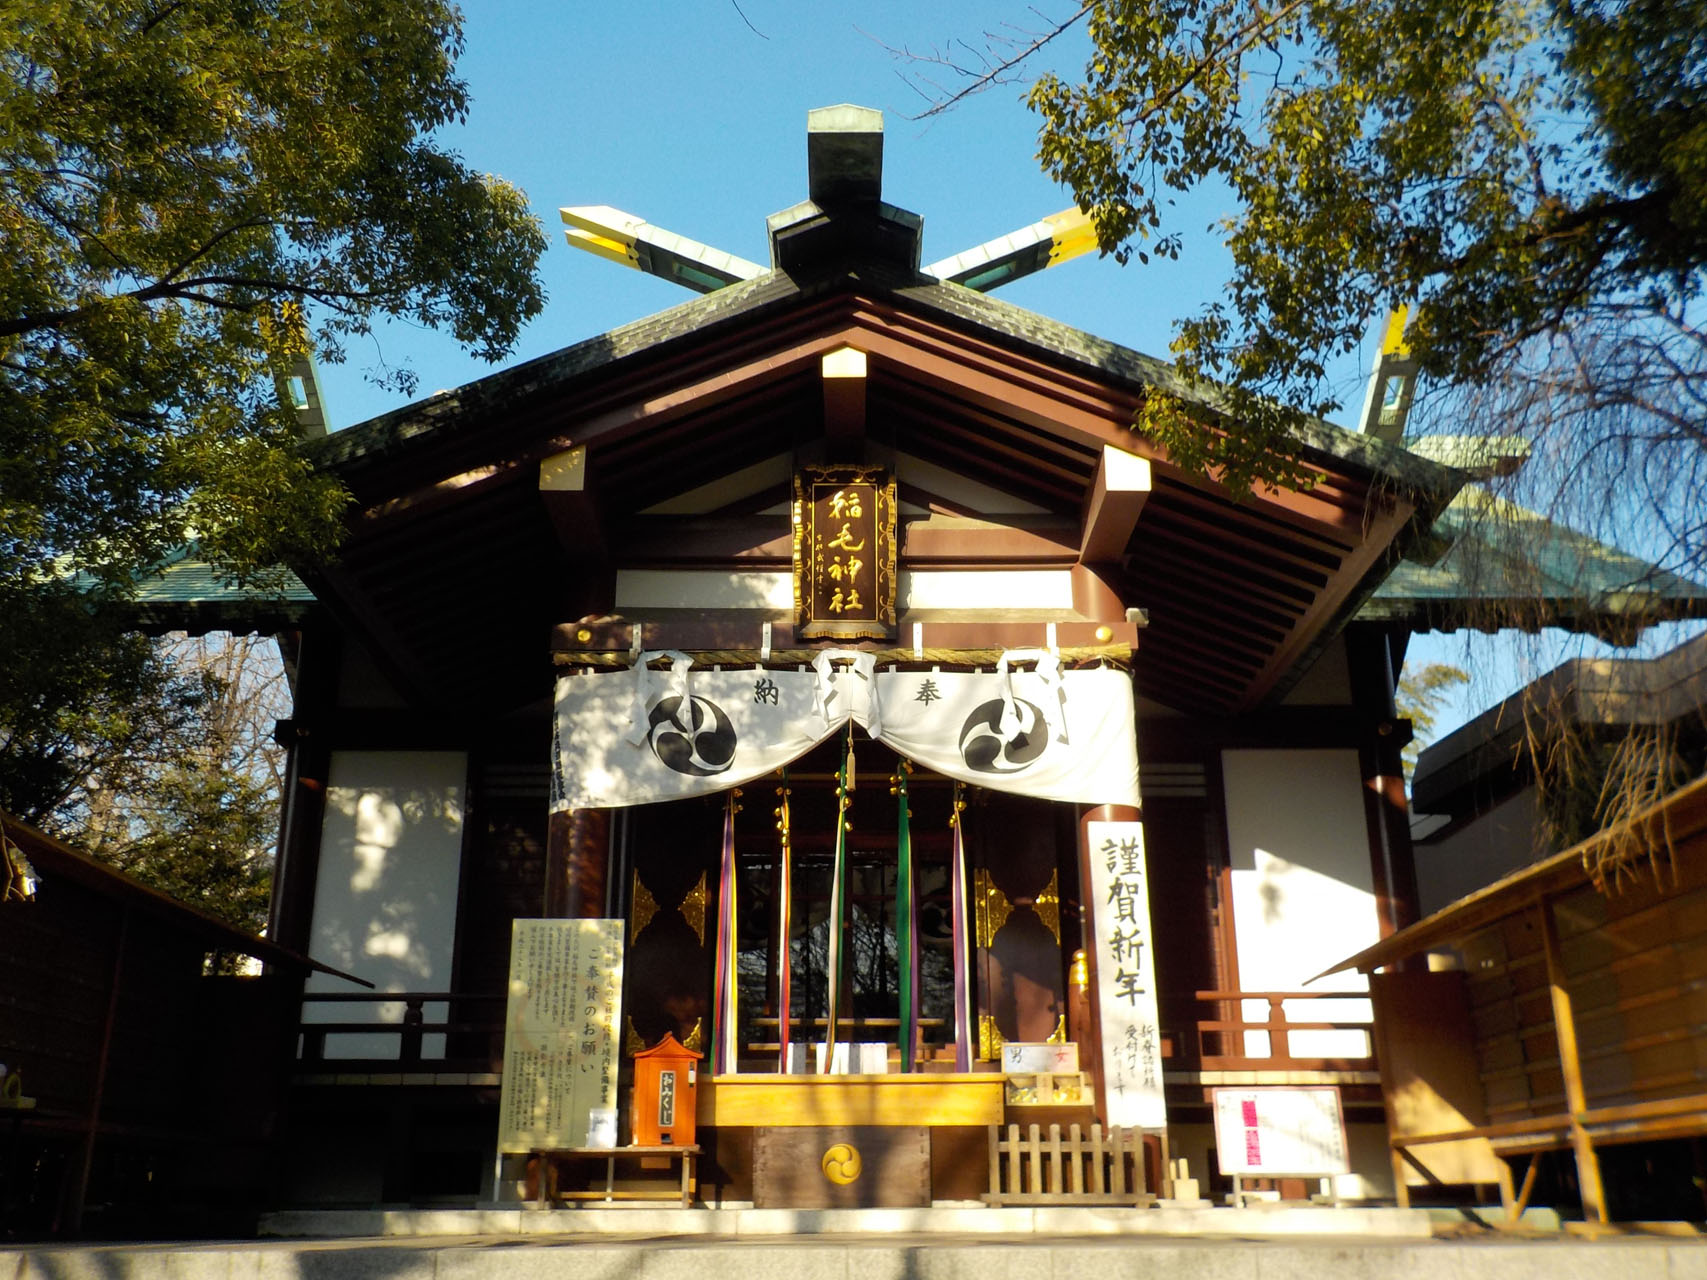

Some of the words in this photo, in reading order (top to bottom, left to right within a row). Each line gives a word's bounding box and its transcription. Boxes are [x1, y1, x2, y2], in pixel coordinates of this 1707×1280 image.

[828, 491, 865, 613] 稲毛神社
[753, 678, 779, 706] 納
[913, 678, 942, 706] 奉
[1100, 836, 1146, 1007] 謹賀新年
[581, 948, 599, 1073] ご奉賛のお願い
[1010, 1047, 1022, 1064] 男
[1056, 1048, 1069, 1062] 女
[661, 1074, 674, 1125] おみくじ
